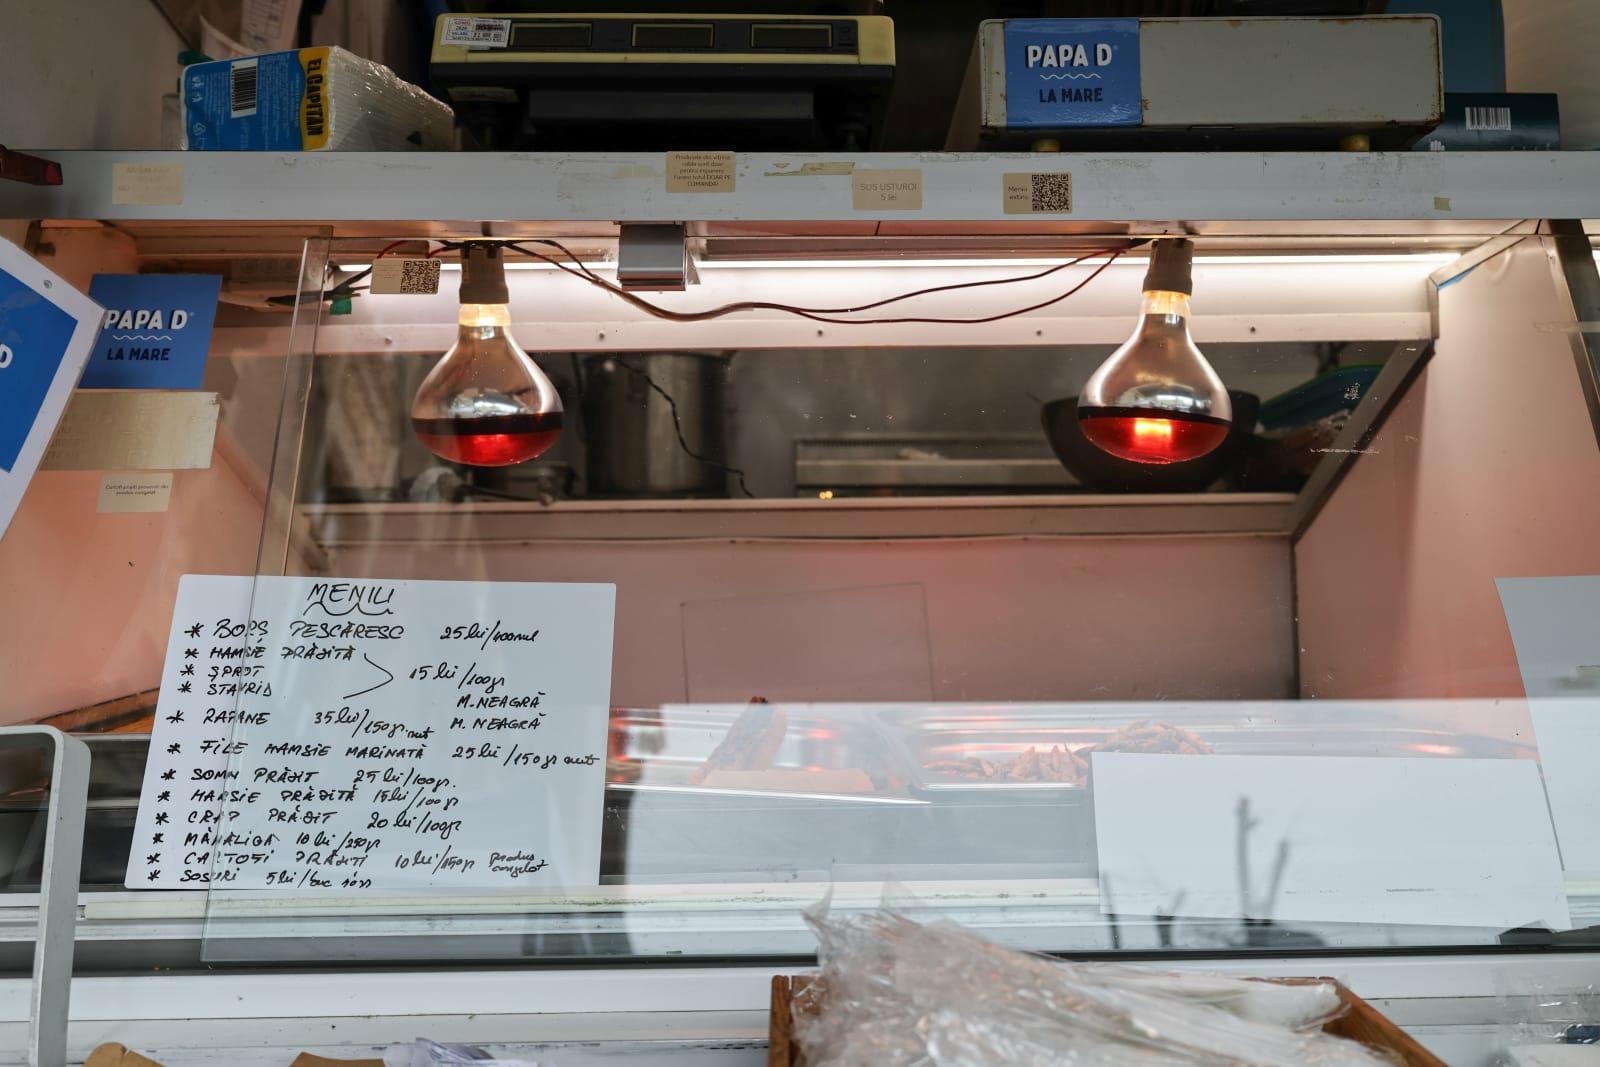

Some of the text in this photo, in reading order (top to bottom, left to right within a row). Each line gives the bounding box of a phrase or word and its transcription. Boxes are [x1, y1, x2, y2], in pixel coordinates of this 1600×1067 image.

[1025, 43, 1112, 68] PAPA D
[306, 57, 323, 136] EL CAPITAN
[1039, 87, 1103, 103] LA MARE
[859, 182, 917, 192] SOS USTUROI
[880, 193, 886, 201] 5
[102, 309, 188, 330] PAPA D
[107, 347, 171, 361] LA MARE
[307, 583, 394, 605] MENIU
[440, 625, 467, 640] 25
[206, 681, 272, 697] STAVRID
[202, 707, 271, 725] RAPANE
[200, 737, 248, 754] FILE
[264, 743, 332, 757] HAMSIE
[452, 745, 477, 759] 25
[191, 768, 239, 780] SOMN
[367, 811, 389, 829] 20
[266, 871, 279, 885] 5
